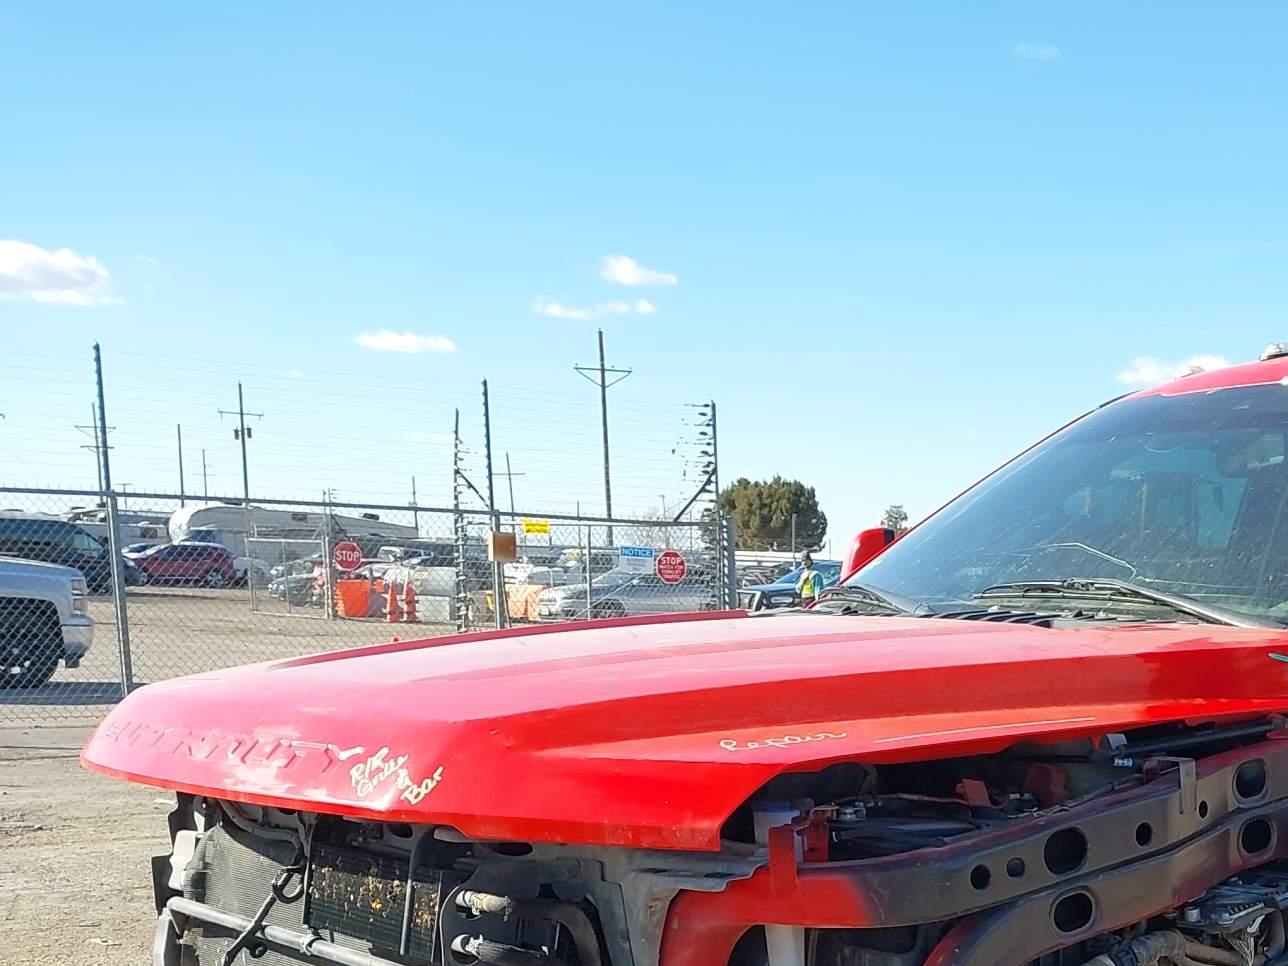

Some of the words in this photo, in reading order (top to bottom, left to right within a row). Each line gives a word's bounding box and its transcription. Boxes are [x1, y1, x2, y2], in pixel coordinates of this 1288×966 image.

[335, 550, 360, 562] STOP
[622, 547, 652, 557] NOTICE
[660, 556, 682, 565] STOP
[400, 765, 445, 805] Bar
